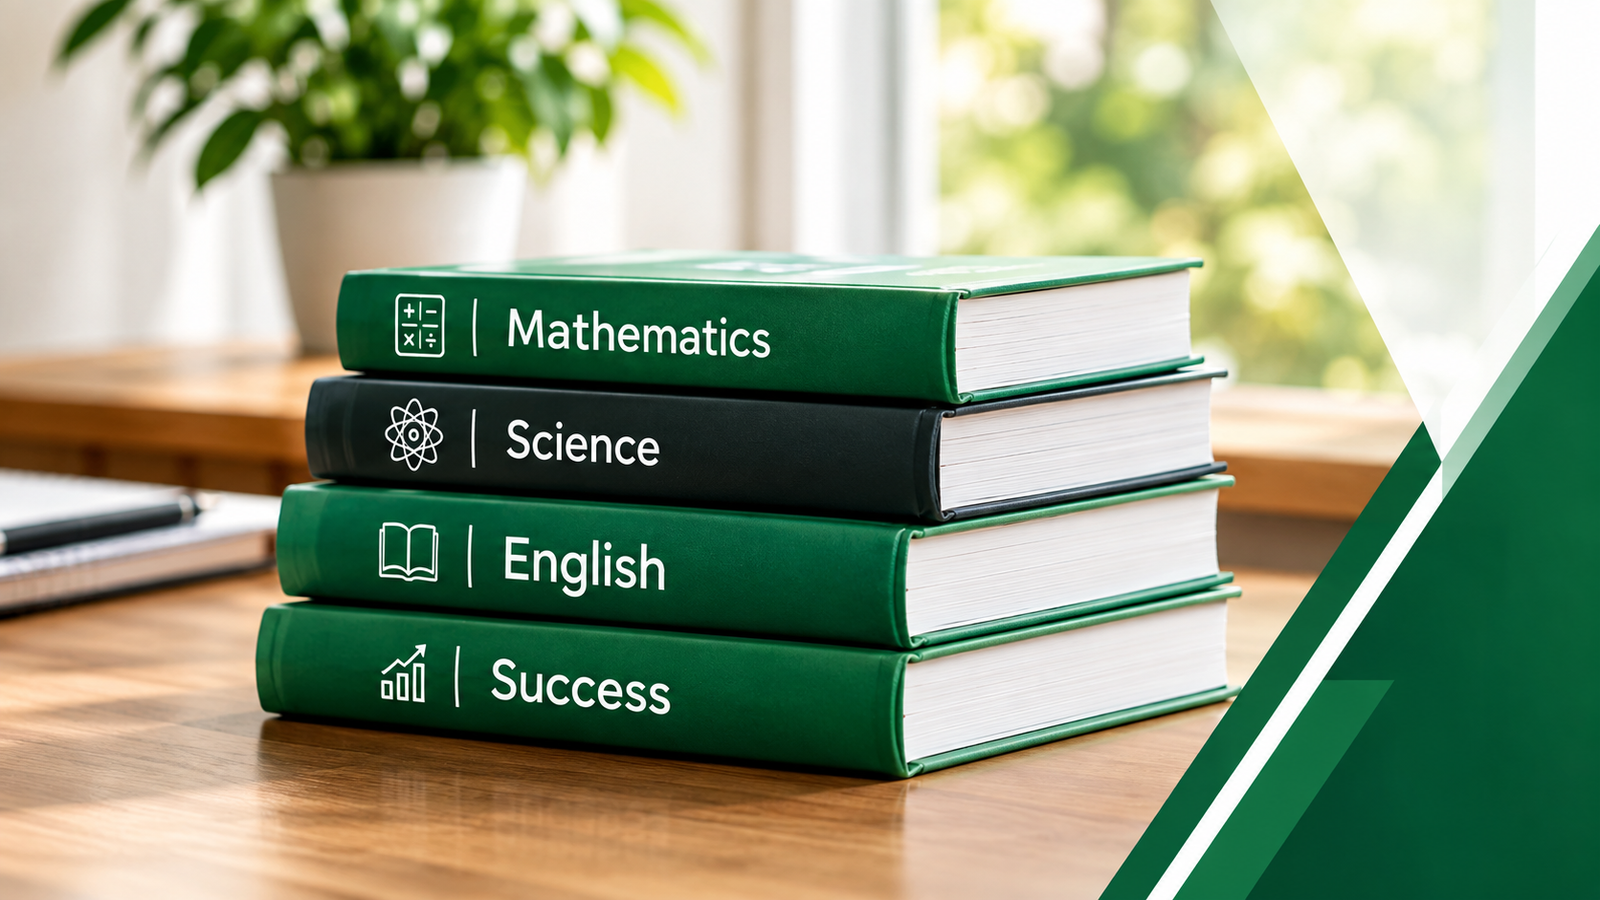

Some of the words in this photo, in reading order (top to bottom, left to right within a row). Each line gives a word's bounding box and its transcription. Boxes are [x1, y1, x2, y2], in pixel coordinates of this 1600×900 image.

[508, 308, 771, 359] Mathematics
[506, 419, 660, 467] Science
[504, 535, 665, 598] English
[491, 658, 671, 715] Success
